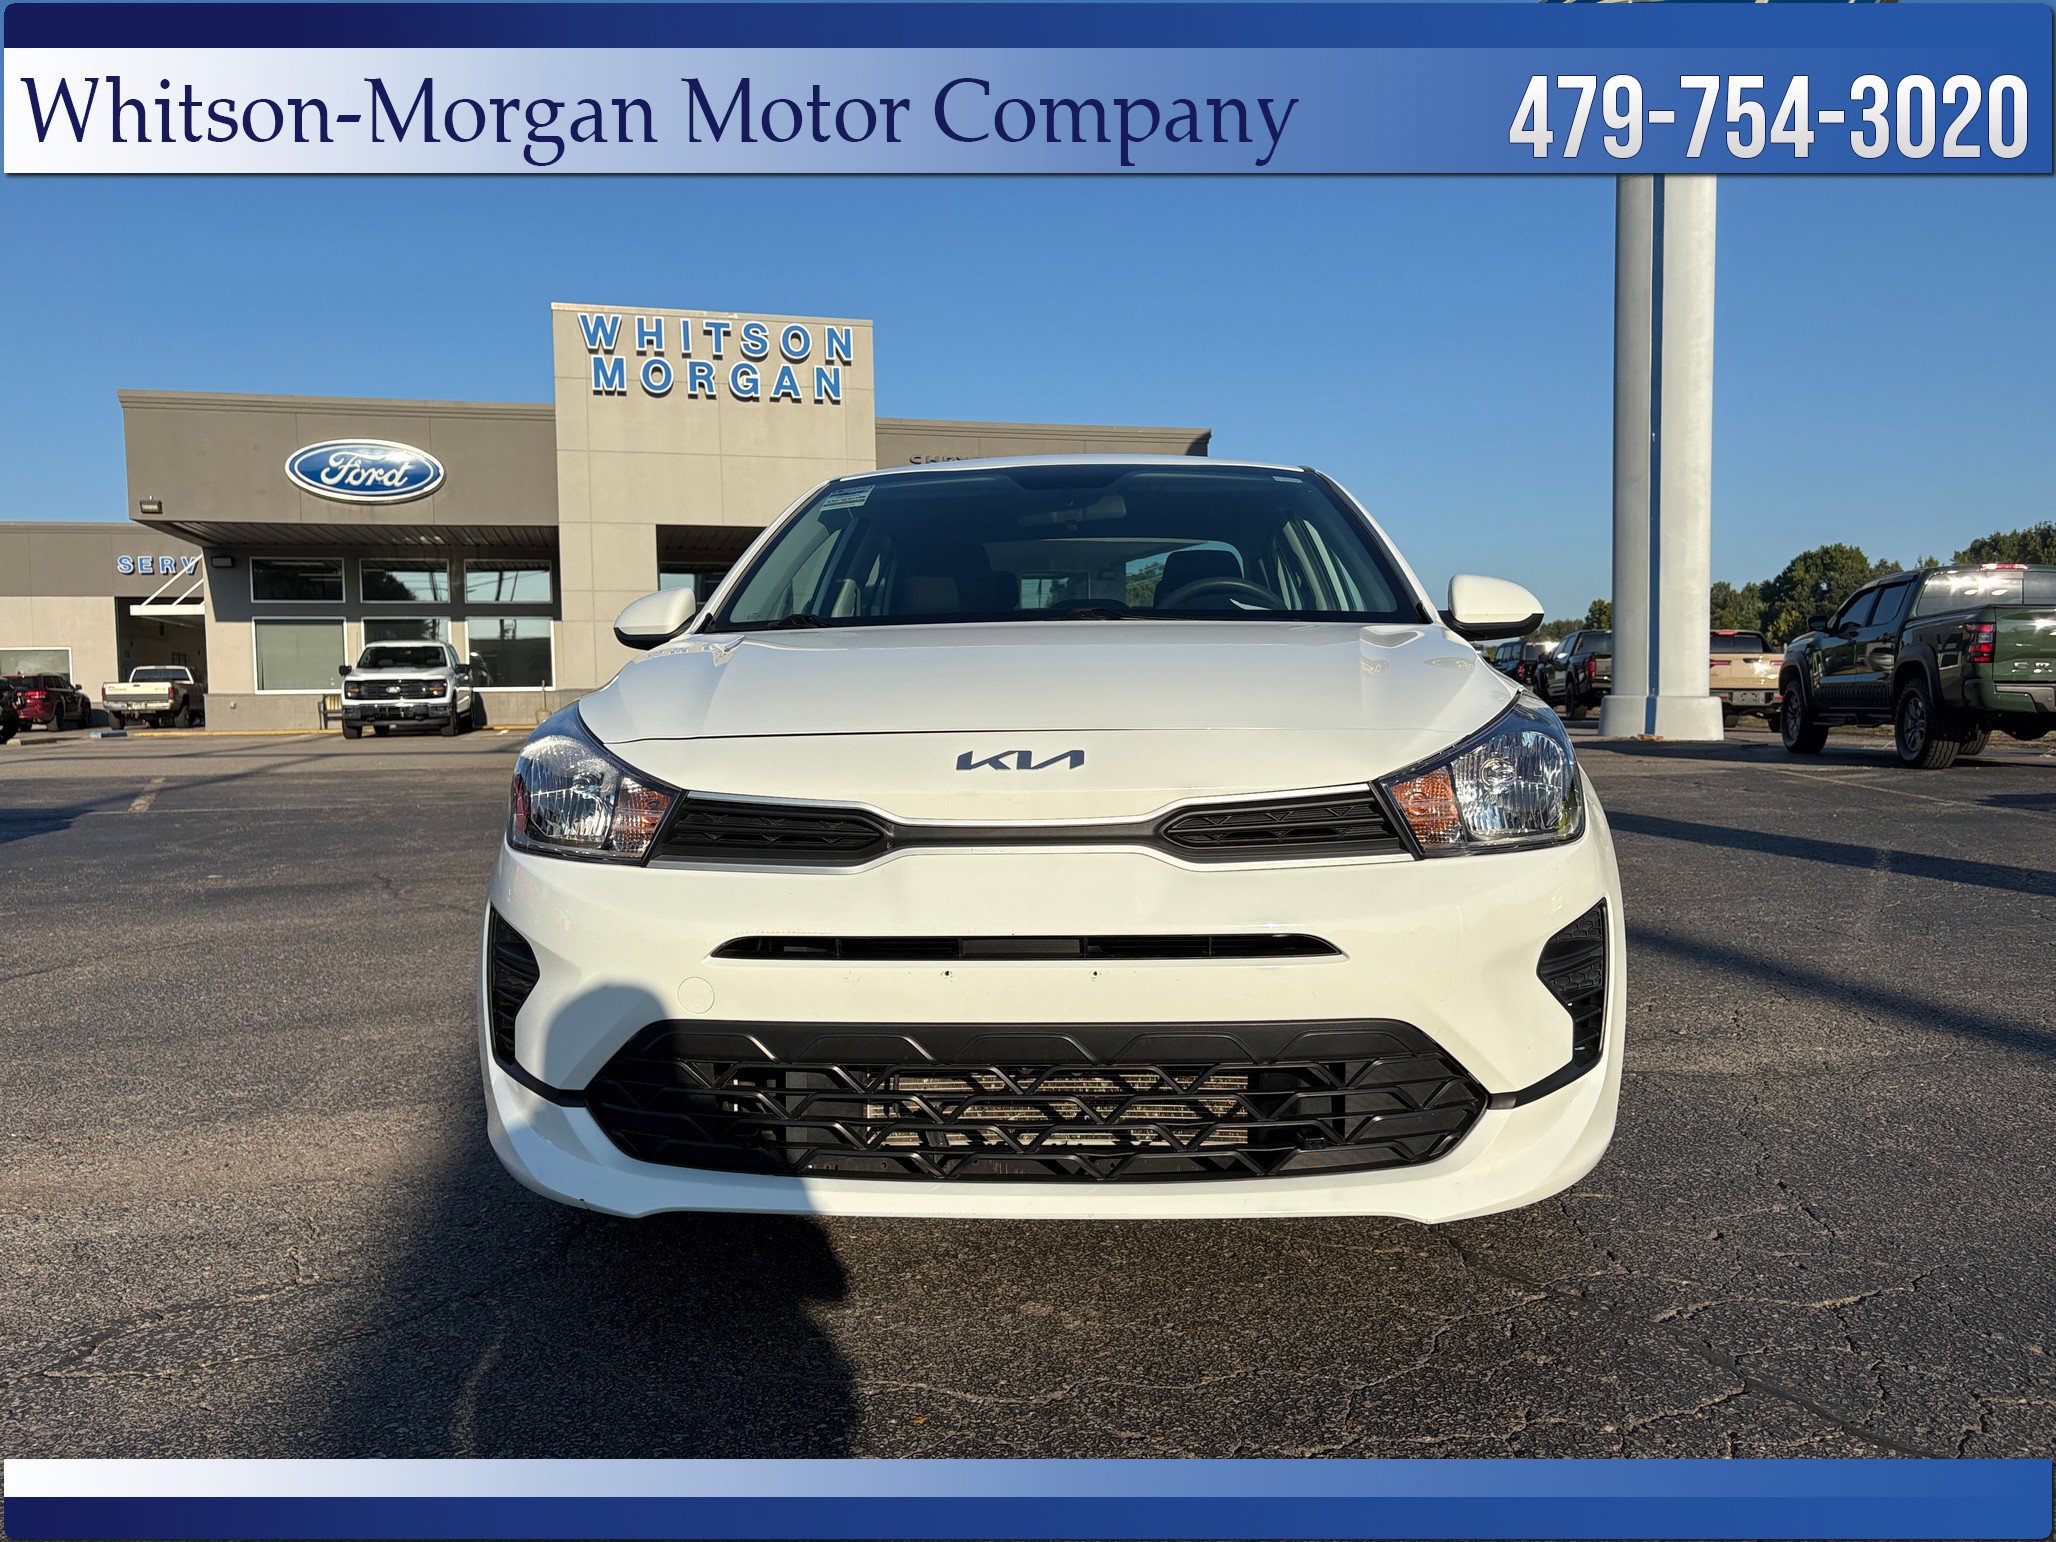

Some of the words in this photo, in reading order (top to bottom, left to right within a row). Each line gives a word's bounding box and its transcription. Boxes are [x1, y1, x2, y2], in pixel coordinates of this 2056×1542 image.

[577, 312, 853, 362] WHITSON
[591, 355, 843, 404] MORGAN
[320, 451, 412, 488] Ford
[956, 749, 1085, 771] KIA
